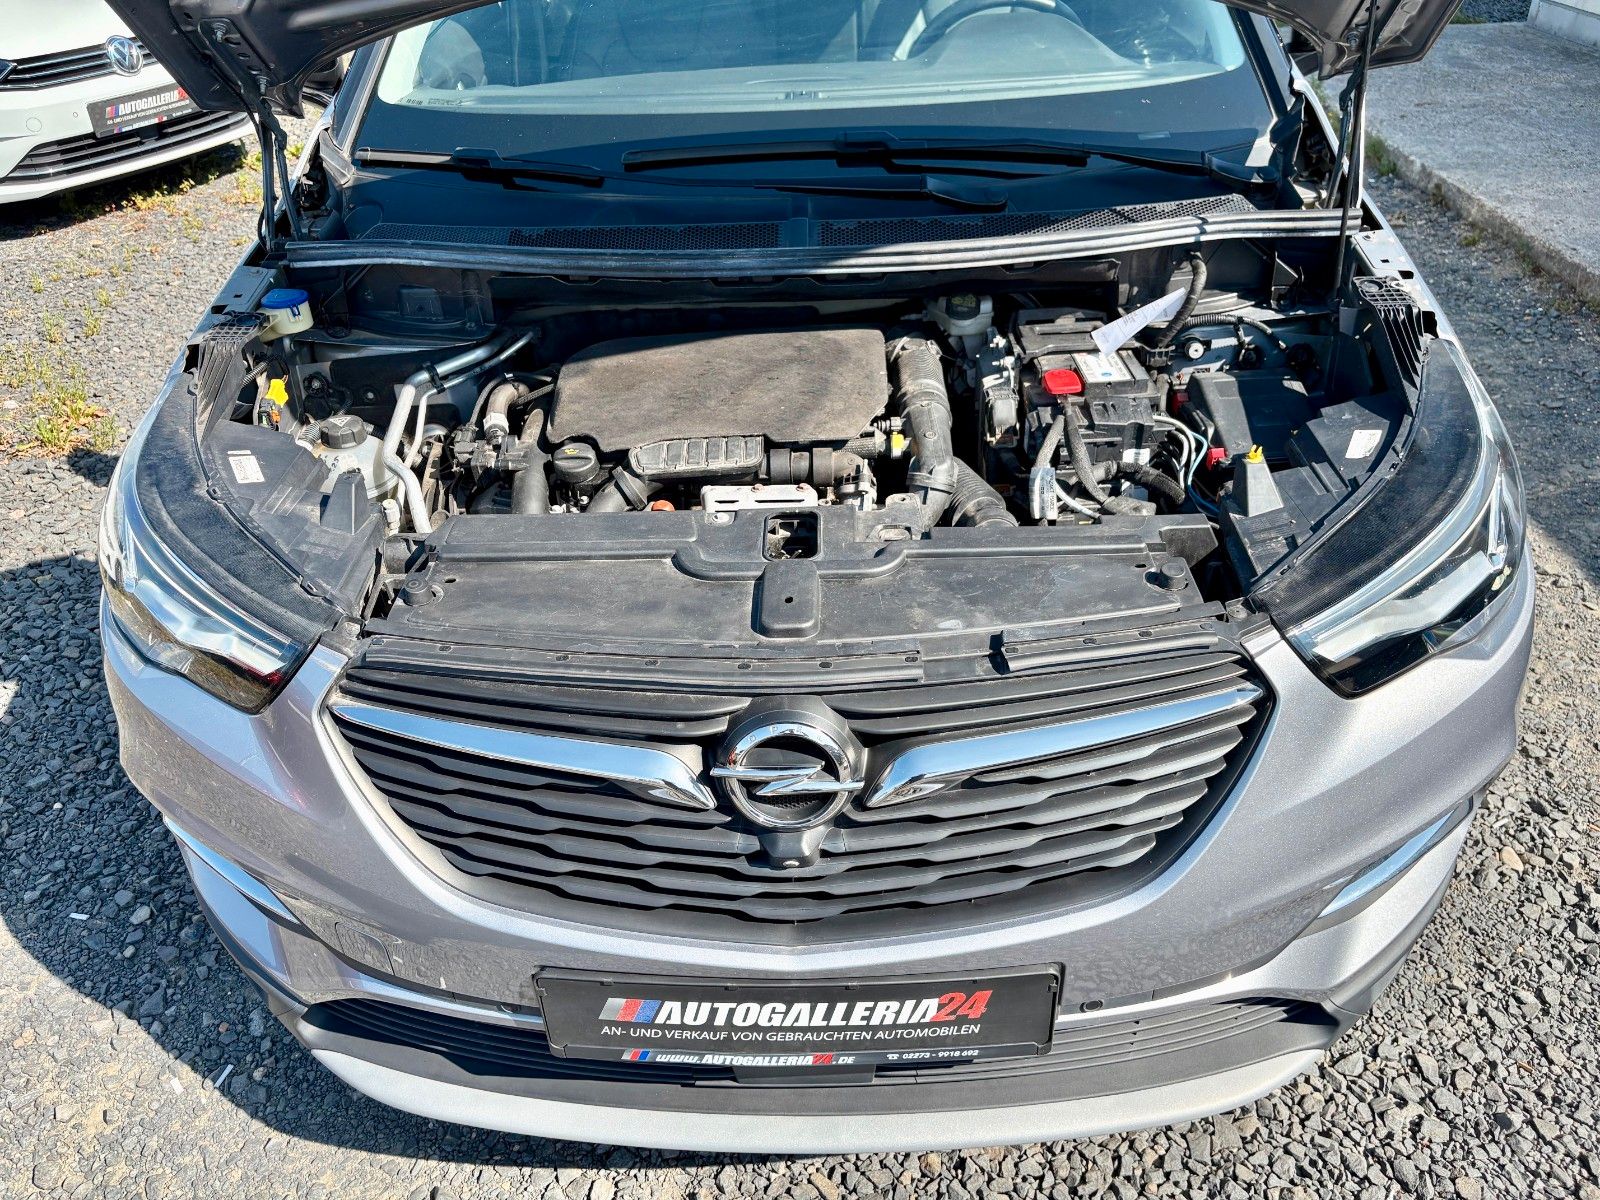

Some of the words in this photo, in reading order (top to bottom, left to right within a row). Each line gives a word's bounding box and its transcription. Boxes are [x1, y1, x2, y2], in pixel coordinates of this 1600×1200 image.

[654, 989, 993, 1027] AUTOGALLERIA24
[601, 1026, 626, 1036] AN-
[630, 1028, 662, 1038] UND
[665, 1030, 728, 1040] VERKAUF
[731, 1031, 763, 1041] VON
[766, 1031, 872, 1041] GEBRAUCHTEN
[874, 1024, 981, 1040] AUTOMOBILEN
